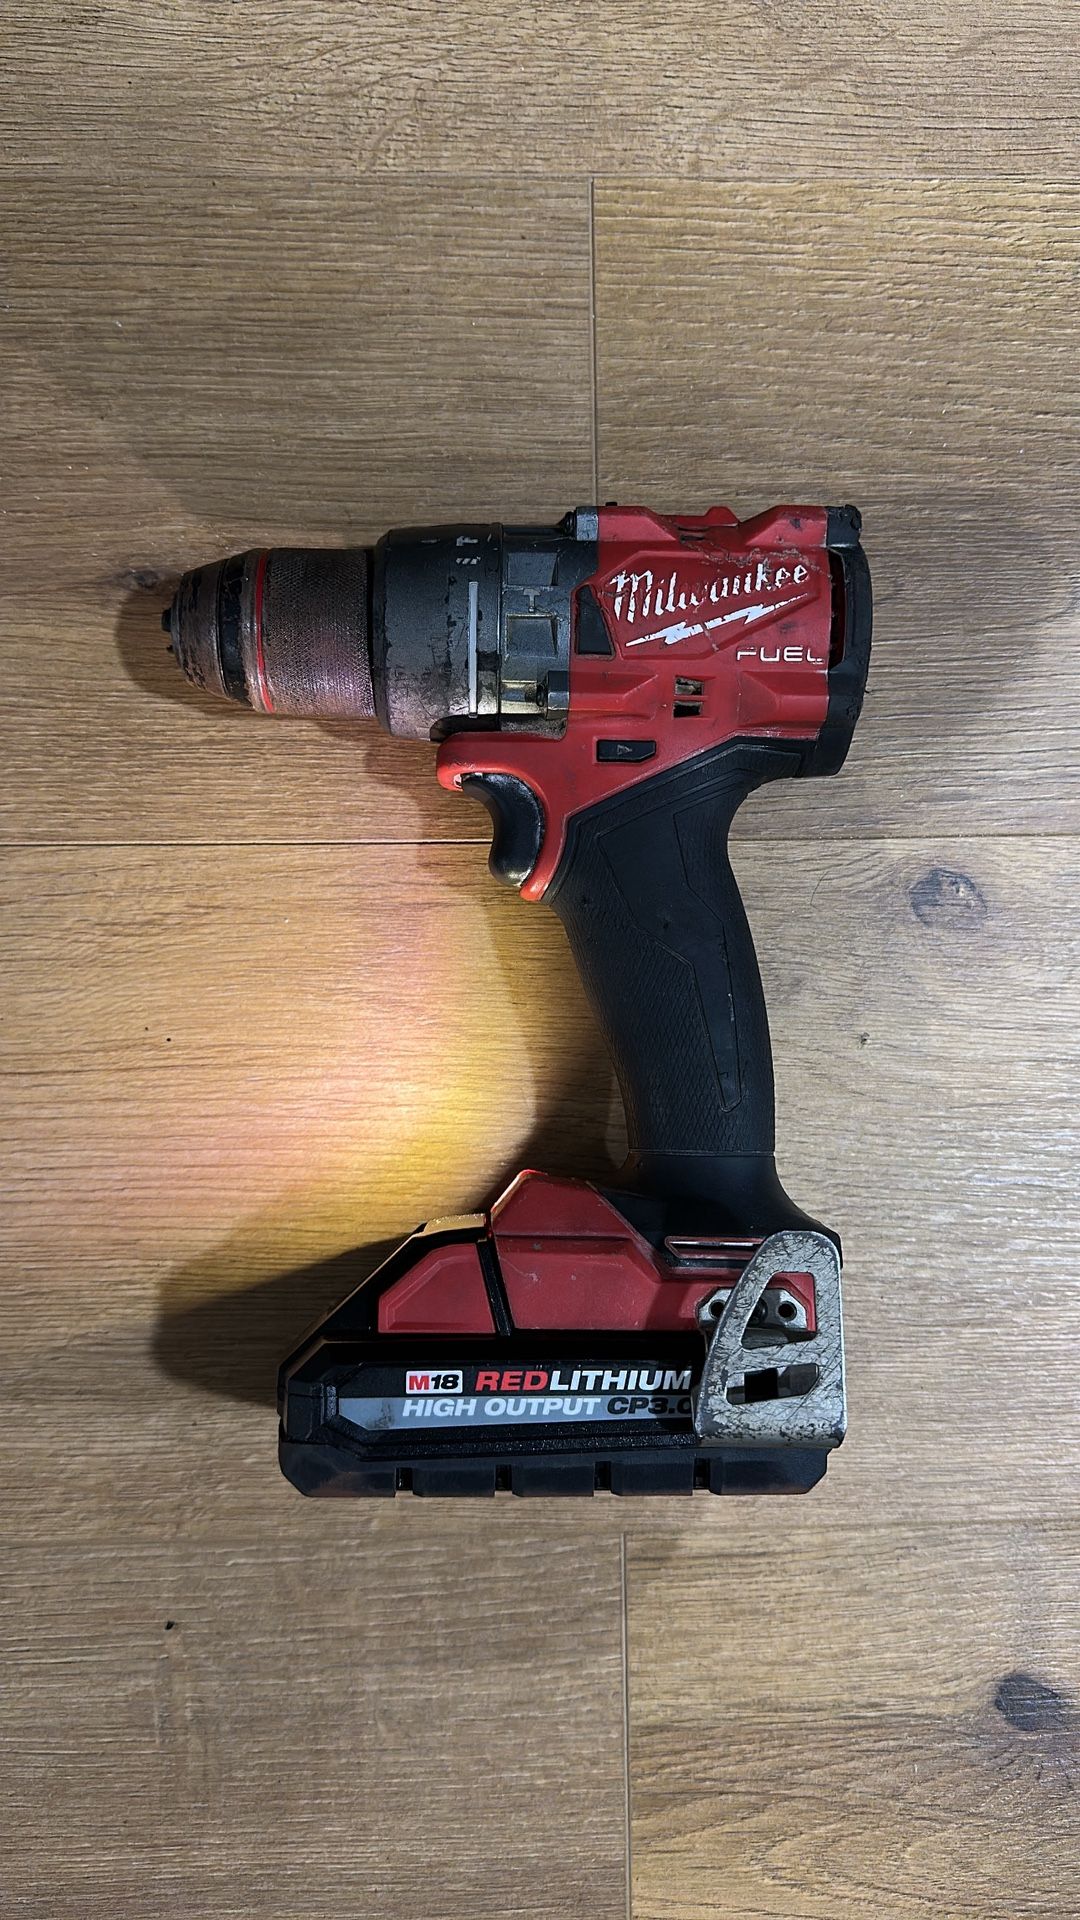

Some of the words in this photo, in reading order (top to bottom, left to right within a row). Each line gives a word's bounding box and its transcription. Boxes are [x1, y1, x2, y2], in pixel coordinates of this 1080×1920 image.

[610, 564, 809, 623] Milwaukee
[737, 647, 824, 664] FUEL
[408, 1374, 460, 1391] M18
[402, 1398, 477, 1417] HIGH
[484, 1397, 600, 1416] OUTPUT
